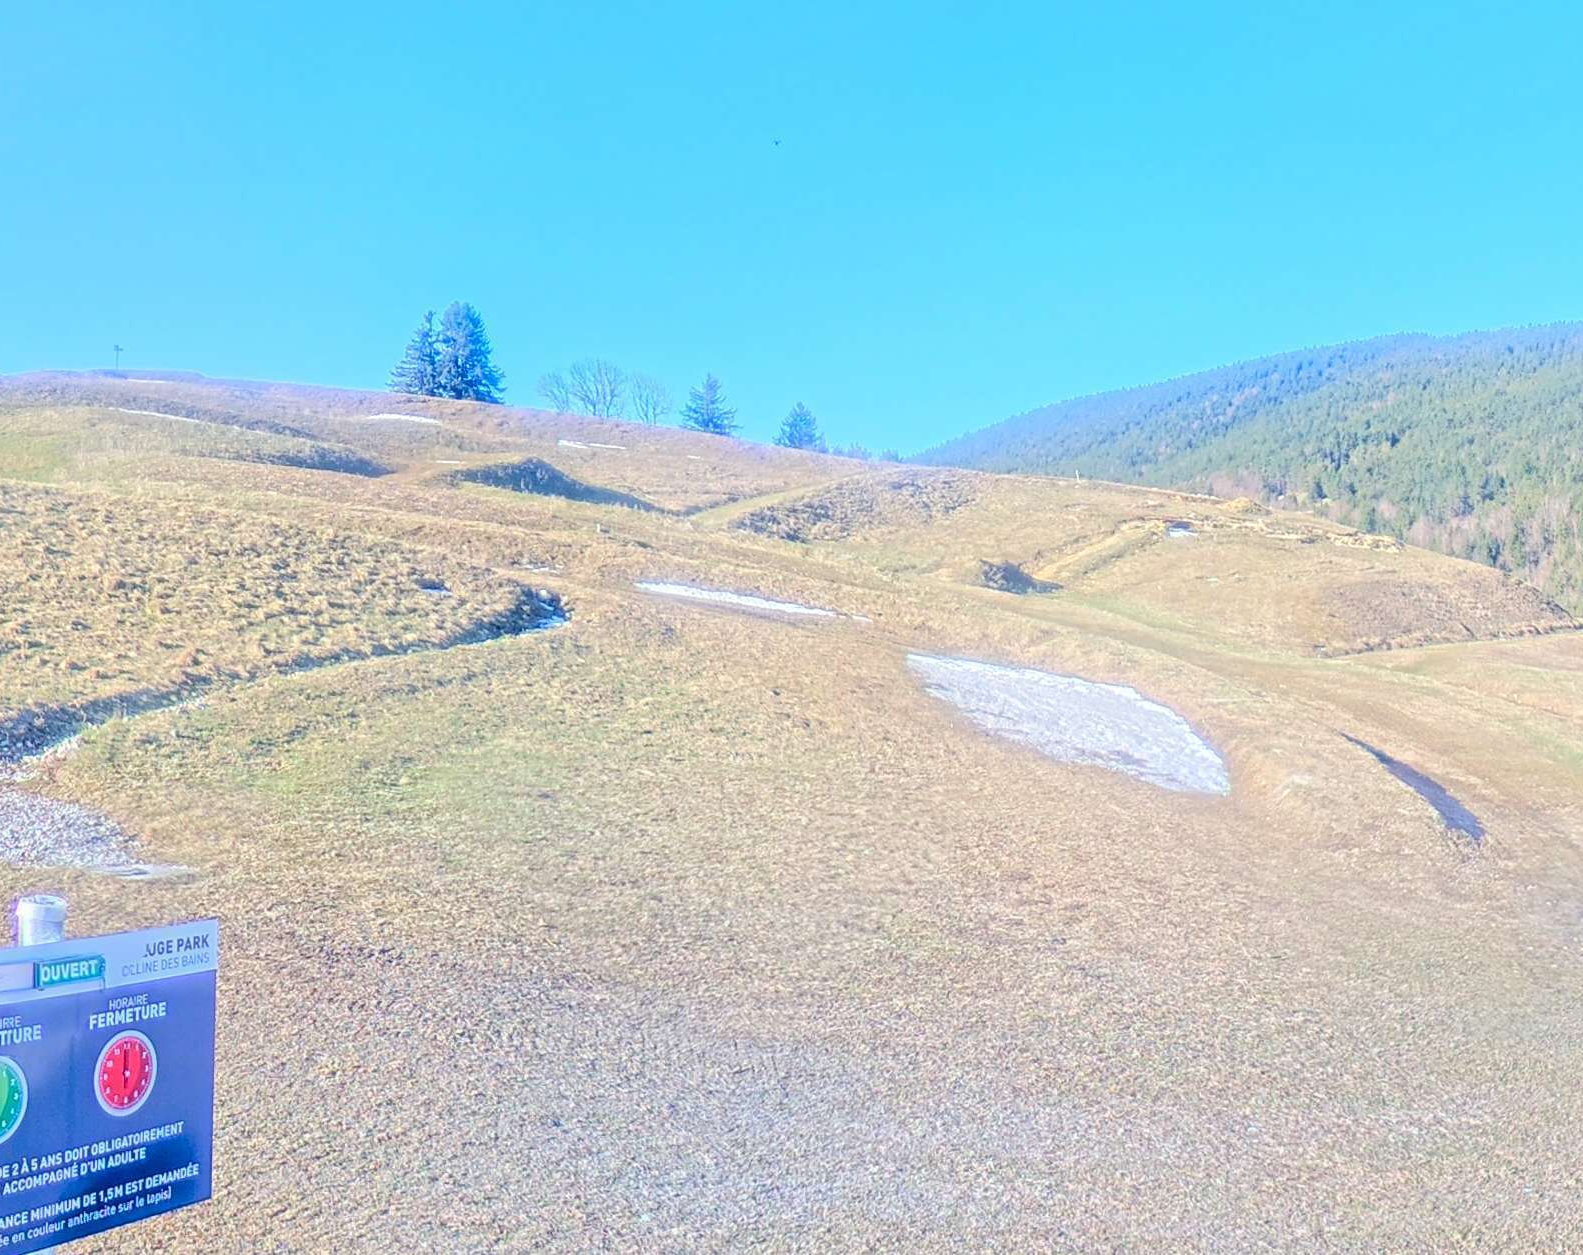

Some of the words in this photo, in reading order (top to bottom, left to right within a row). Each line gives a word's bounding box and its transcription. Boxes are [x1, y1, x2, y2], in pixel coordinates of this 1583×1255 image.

[177, 934, 210, 952] PARK
[41, 959, 99, 982] OUVERT
[161, 957, 179, 971] DES
[181, 951, 210, 968] BAINS
[89, 1001, 167, 1030] FERMETURE
[109, 993, 149, 1010] HORAIRE
[12, 1163, 19, 1176] 2
[21, 1157, 29, 1174] À
[31, 1158, 38, 1171] 5
[40, 1152, 63, 1169] ANS
[65, 1145, 90, 1163] DOIT
[91, 1121, 184, 1155] OBLIGATOIREMENT
[3, 1161, 79, 1195] ACCOMPAGNÉ
[108, 1147, 146, 1168] ADULTE
[30, 1196, 81, 1222] MINIMUM
[83, 1192, 97, 1208] DE
[125, 1179, 144, 1195] EST
[145, 1162, 200, 1189] DEMANDÉE
[12, 1231, 25, 1244] en
[27, 1219, 65, 1241] couleur
[67, 1204, 117, 1228] anthracite
[118, 1200, 134, 1213] sur
